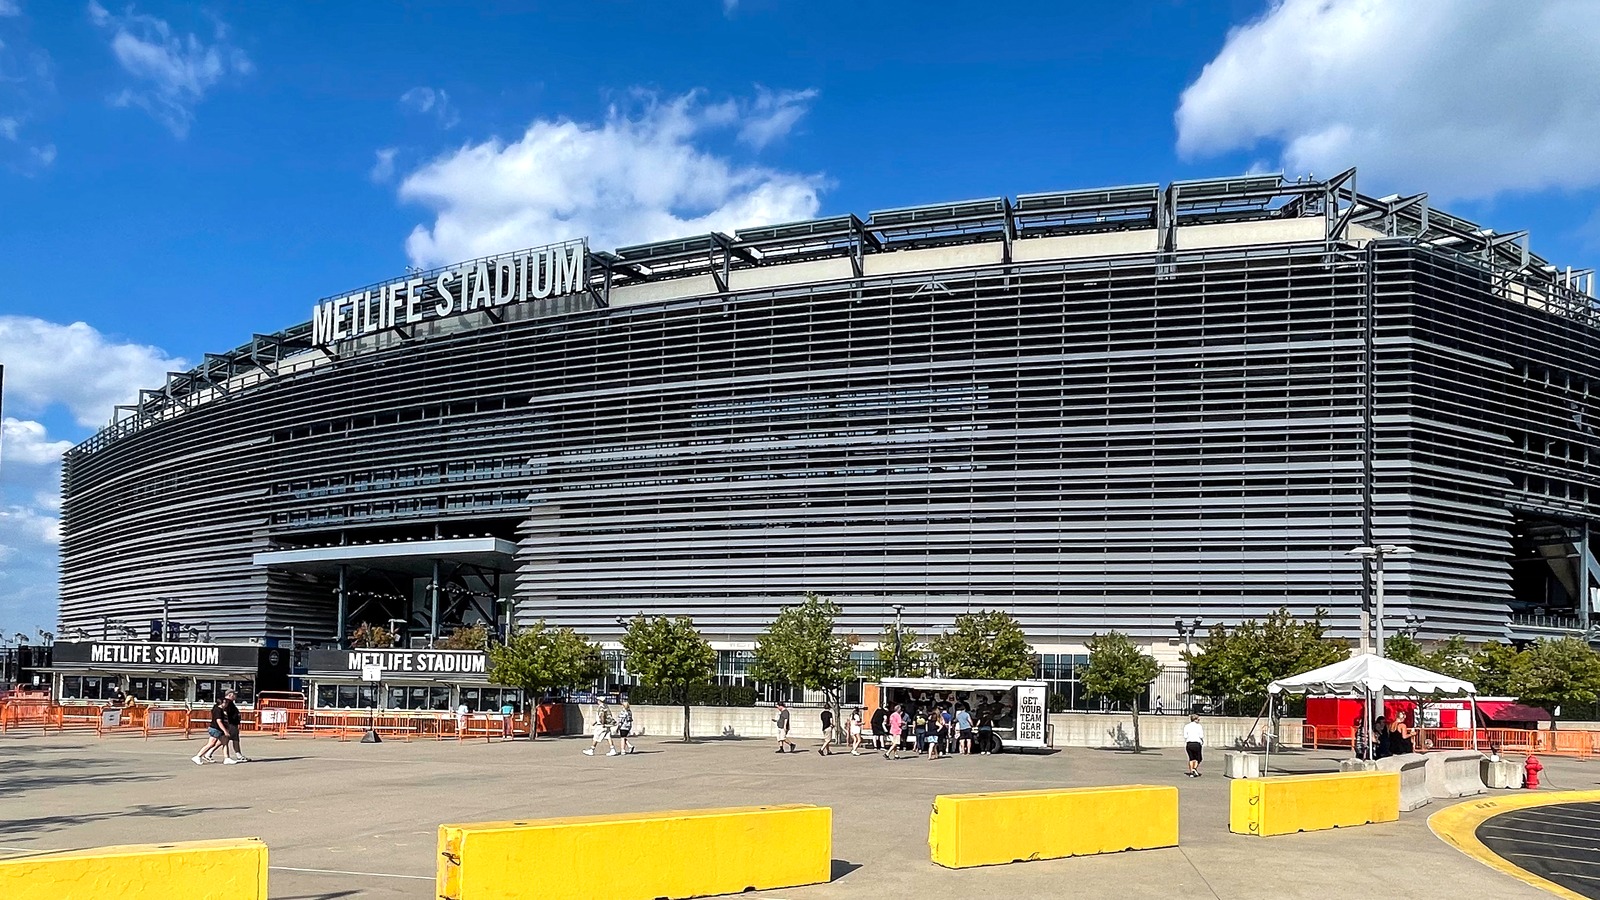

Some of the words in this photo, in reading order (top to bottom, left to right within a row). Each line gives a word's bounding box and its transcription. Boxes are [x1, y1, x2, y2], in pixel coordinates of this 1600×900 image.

[312, 277, 425, 346] METLIFE
[435, 244, 585, 317] STADIUM
[91, 645, 151, 663] METLIFE
[155, 646, 219, 665] STADIUM
[348, 652, 412, 671] METLIFE
[416, 653, 485, 673] STADIUM
[1021, 705, 1042, 714] YOUR
[1020, 714, 1042, 722] TEAM
[1020, 722, 1041, 731] GEAR
[1020, 731, 1041, 739] HERE
